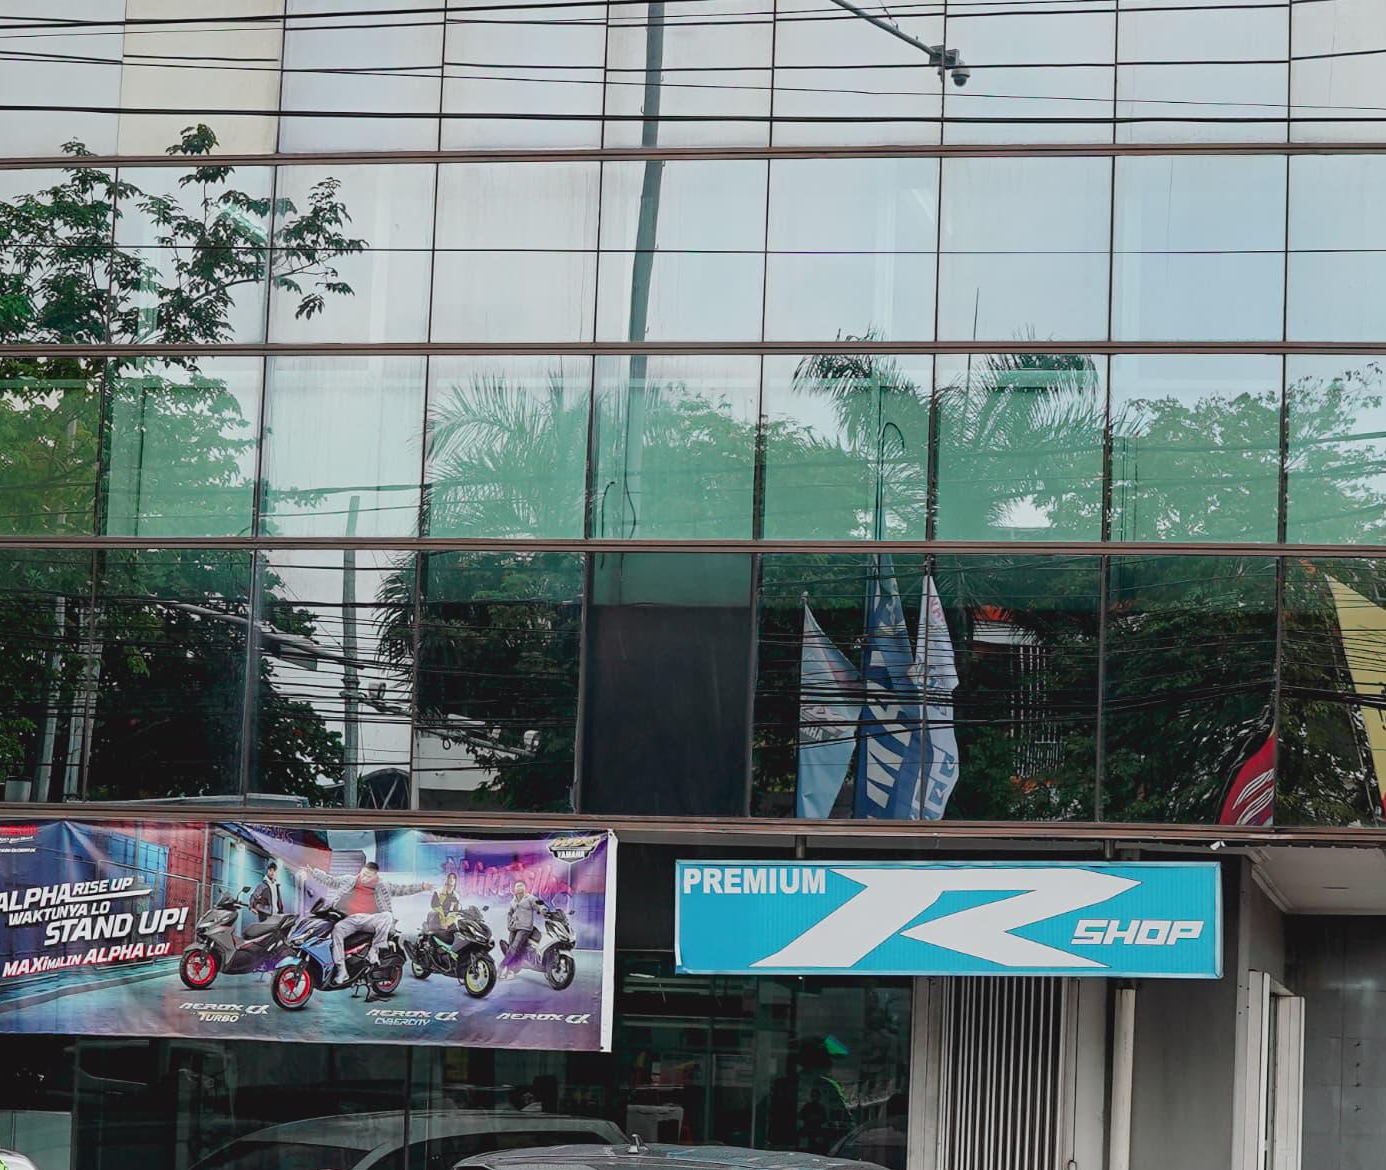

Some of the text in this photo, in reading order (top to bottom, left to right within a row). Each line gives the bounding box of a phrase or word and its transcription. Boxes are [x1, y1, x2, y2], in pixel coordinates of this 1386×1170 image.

[72, 879, 109, 896] RISE
[111, 877, 134, 891] UP
[8, 901, 110, 926] WAKTUNYA LO
[683, 868, 826, 895] PREMIUM
[1070, 919, 1205, 946] SHOP
[44, 906, 189, 946] STAND UP!
[83, 942, 145, 965] ALPHA
[146, 942, 171, 957] LO!
